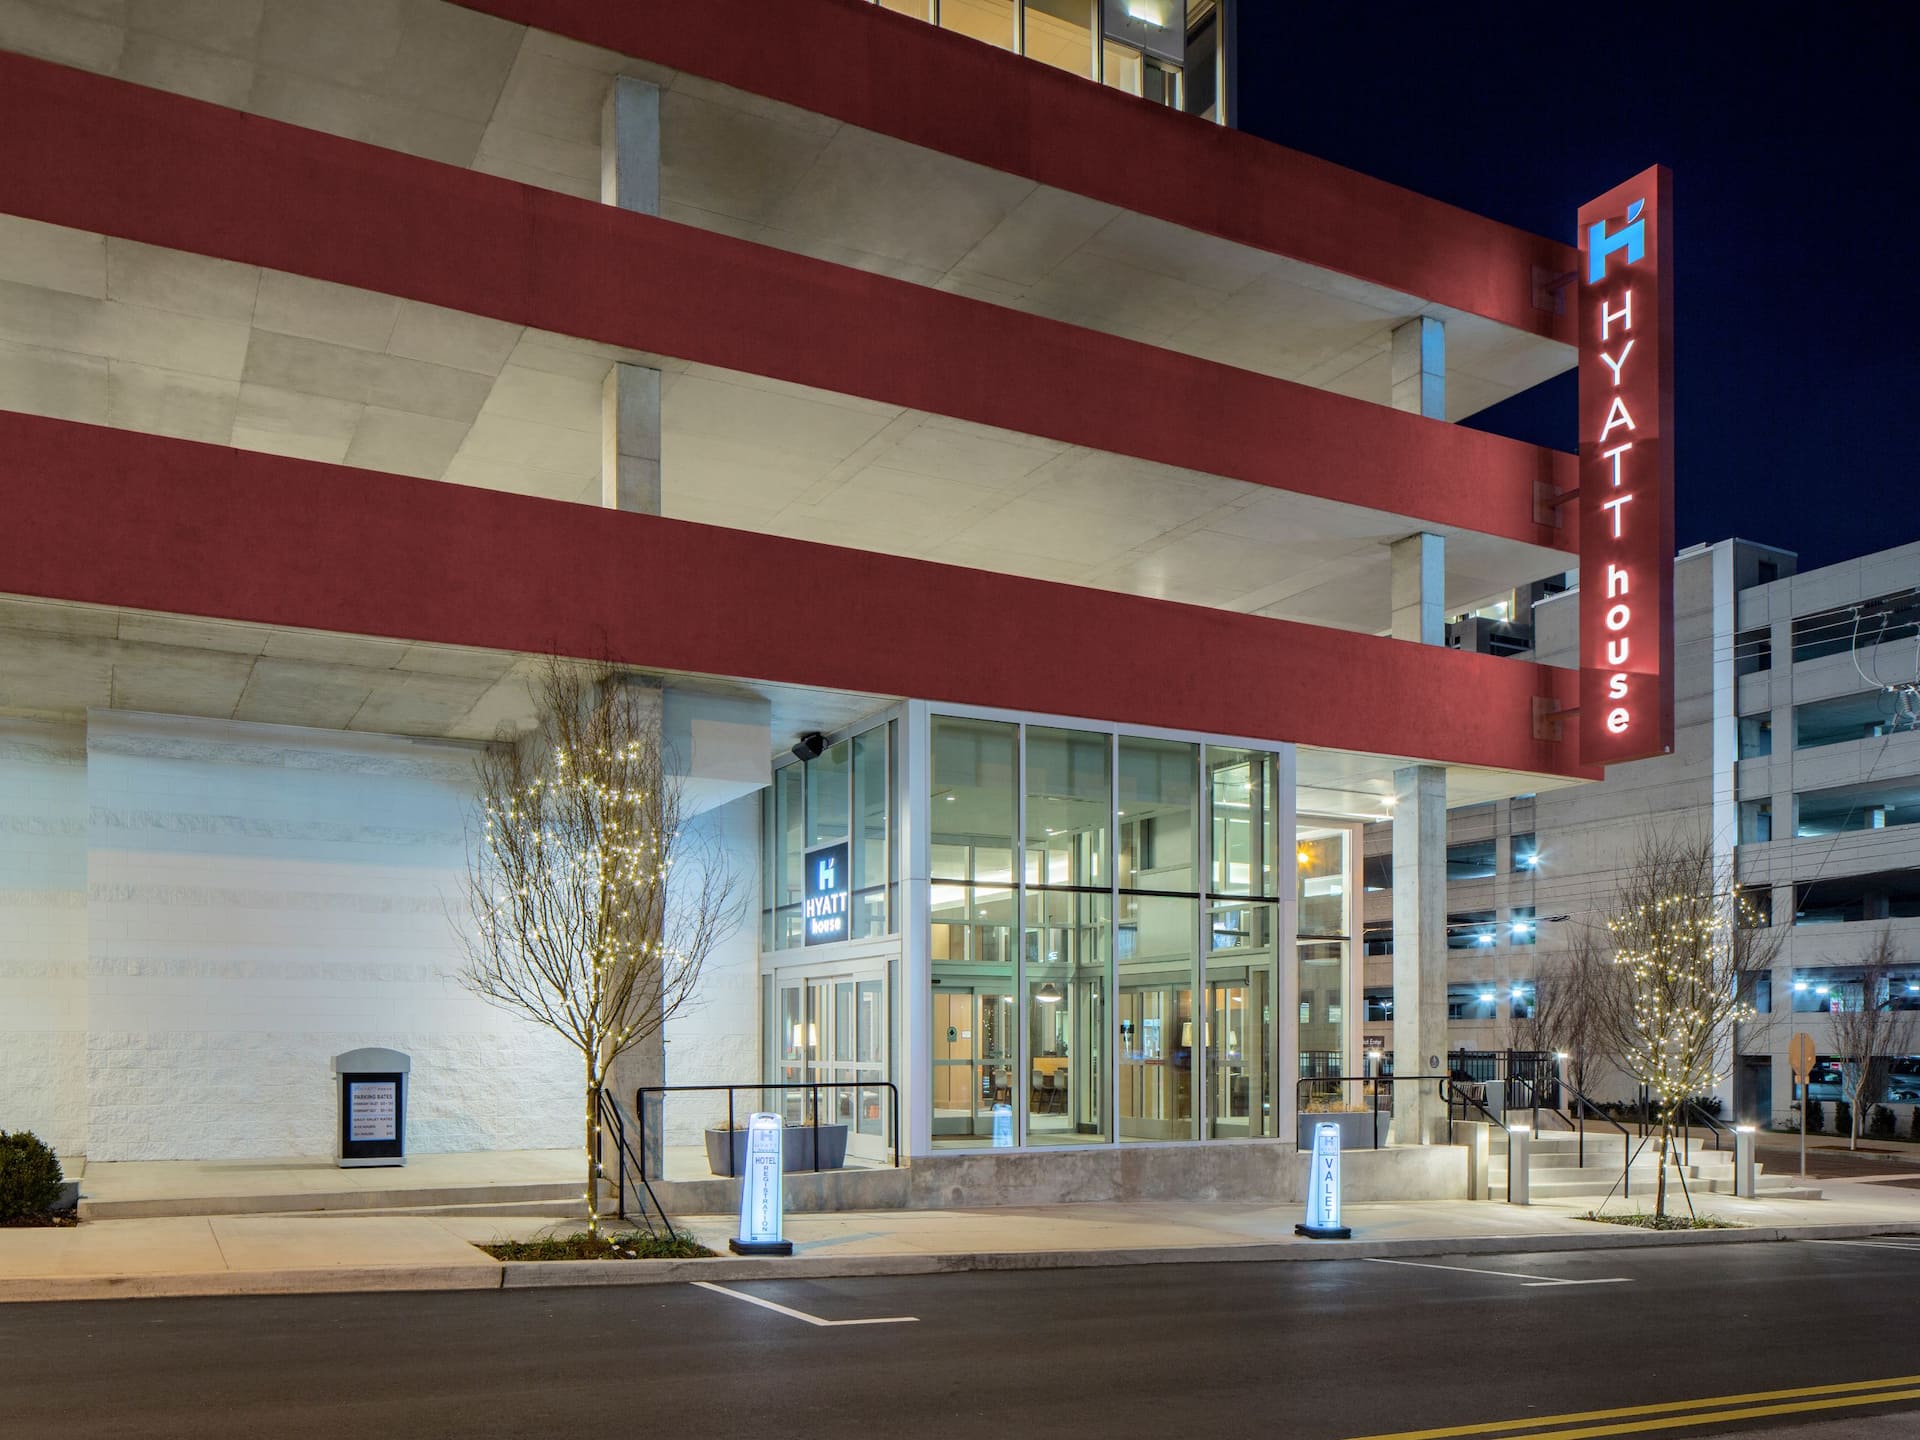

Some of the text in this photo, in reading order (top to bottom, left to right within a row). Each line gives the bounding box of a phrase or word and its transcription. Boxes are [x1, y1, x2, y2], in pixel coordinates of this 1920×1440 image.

[1600, 290, 1636, 734] HYATT house
[806, 892, 848, 918] HYATT
[812, 917, 841, 935] house
[755, 1156, 777, 1165] HOTEL
[1325, 1158, 1334, 1219] VALET
